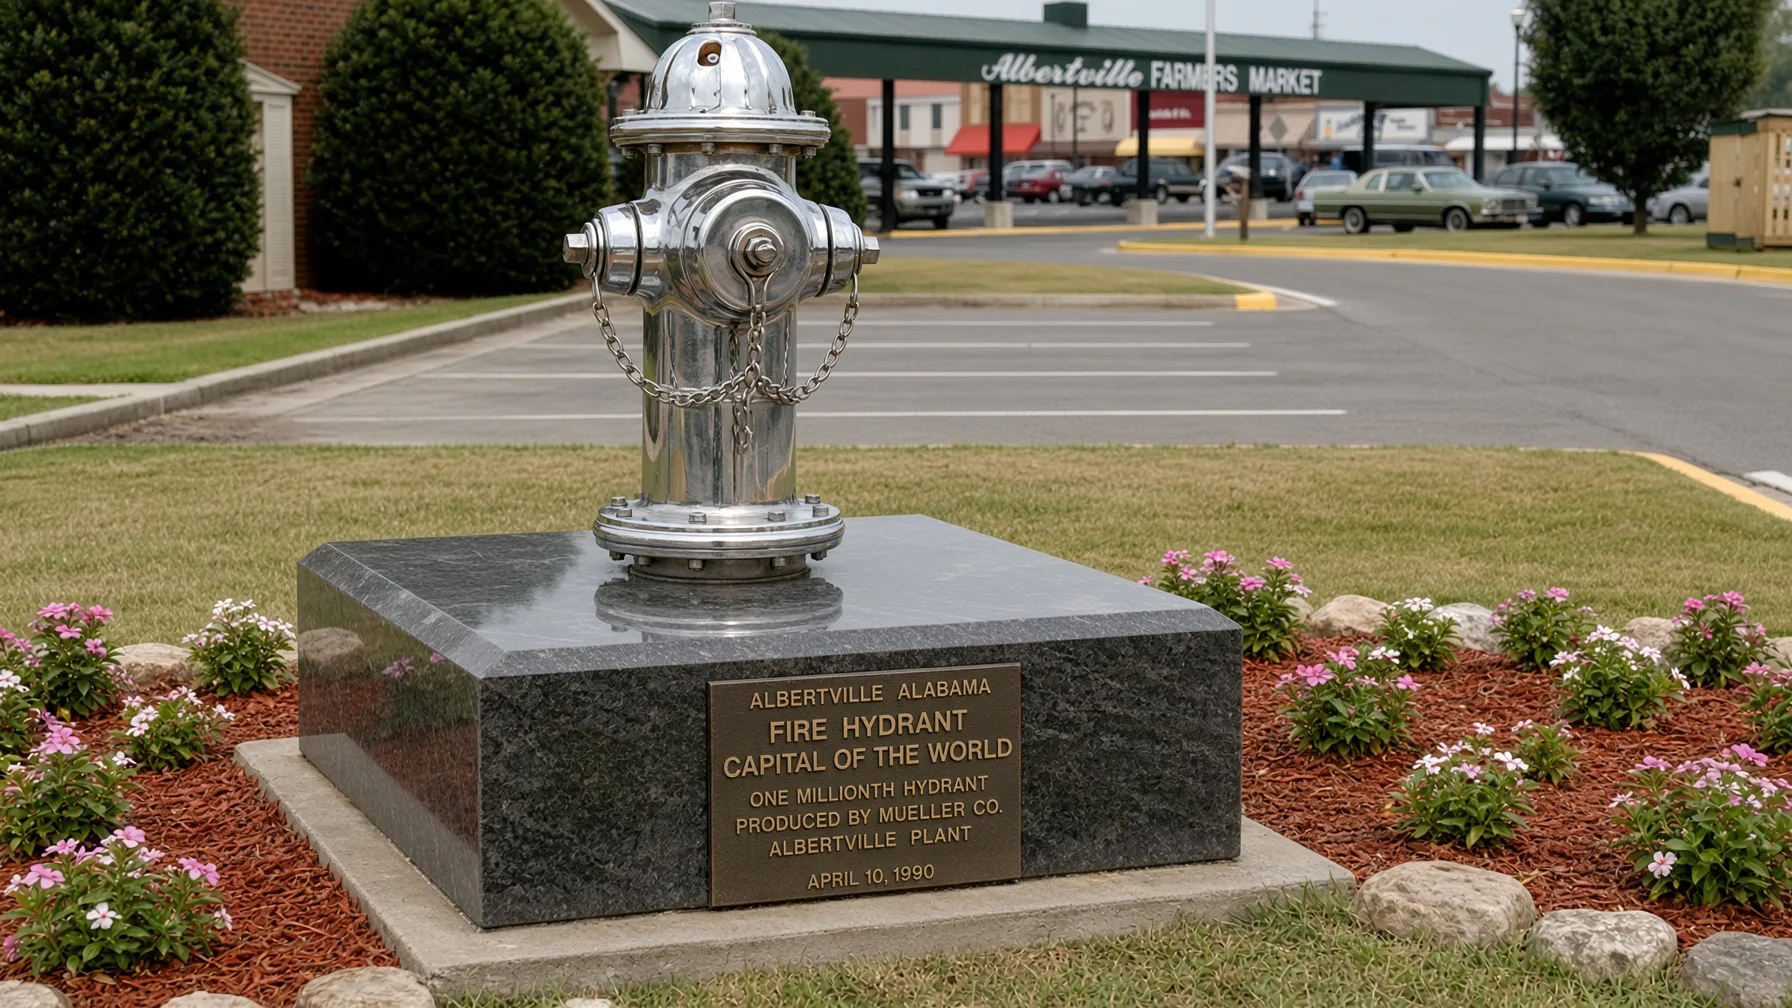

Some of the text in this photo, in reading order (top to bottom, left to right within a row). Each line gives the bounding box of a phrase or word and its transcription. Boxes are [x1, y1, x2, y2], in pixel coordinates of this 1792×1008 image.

[981, 53, 1144, 88] Albertville
[1249, 66, 1323, 95] MARKET
[750, 678, 992, 710] ALBERTVILLE ALABAMA
[769, 709, 968, 744] FIRE HYDRANT
[722, 737, 1014, 779] CAPITAL OF THE WORLD
[749, 775, 989, 808] ONE MILLIONTH HYDRANT
[736, 799, 1004, 835] PRODUCED BY MUELLER CO.
[769, 825, 972, 857] ALBERTVILLE PLANT
[806, 864, 935, 890] APRIL 10, 1990
